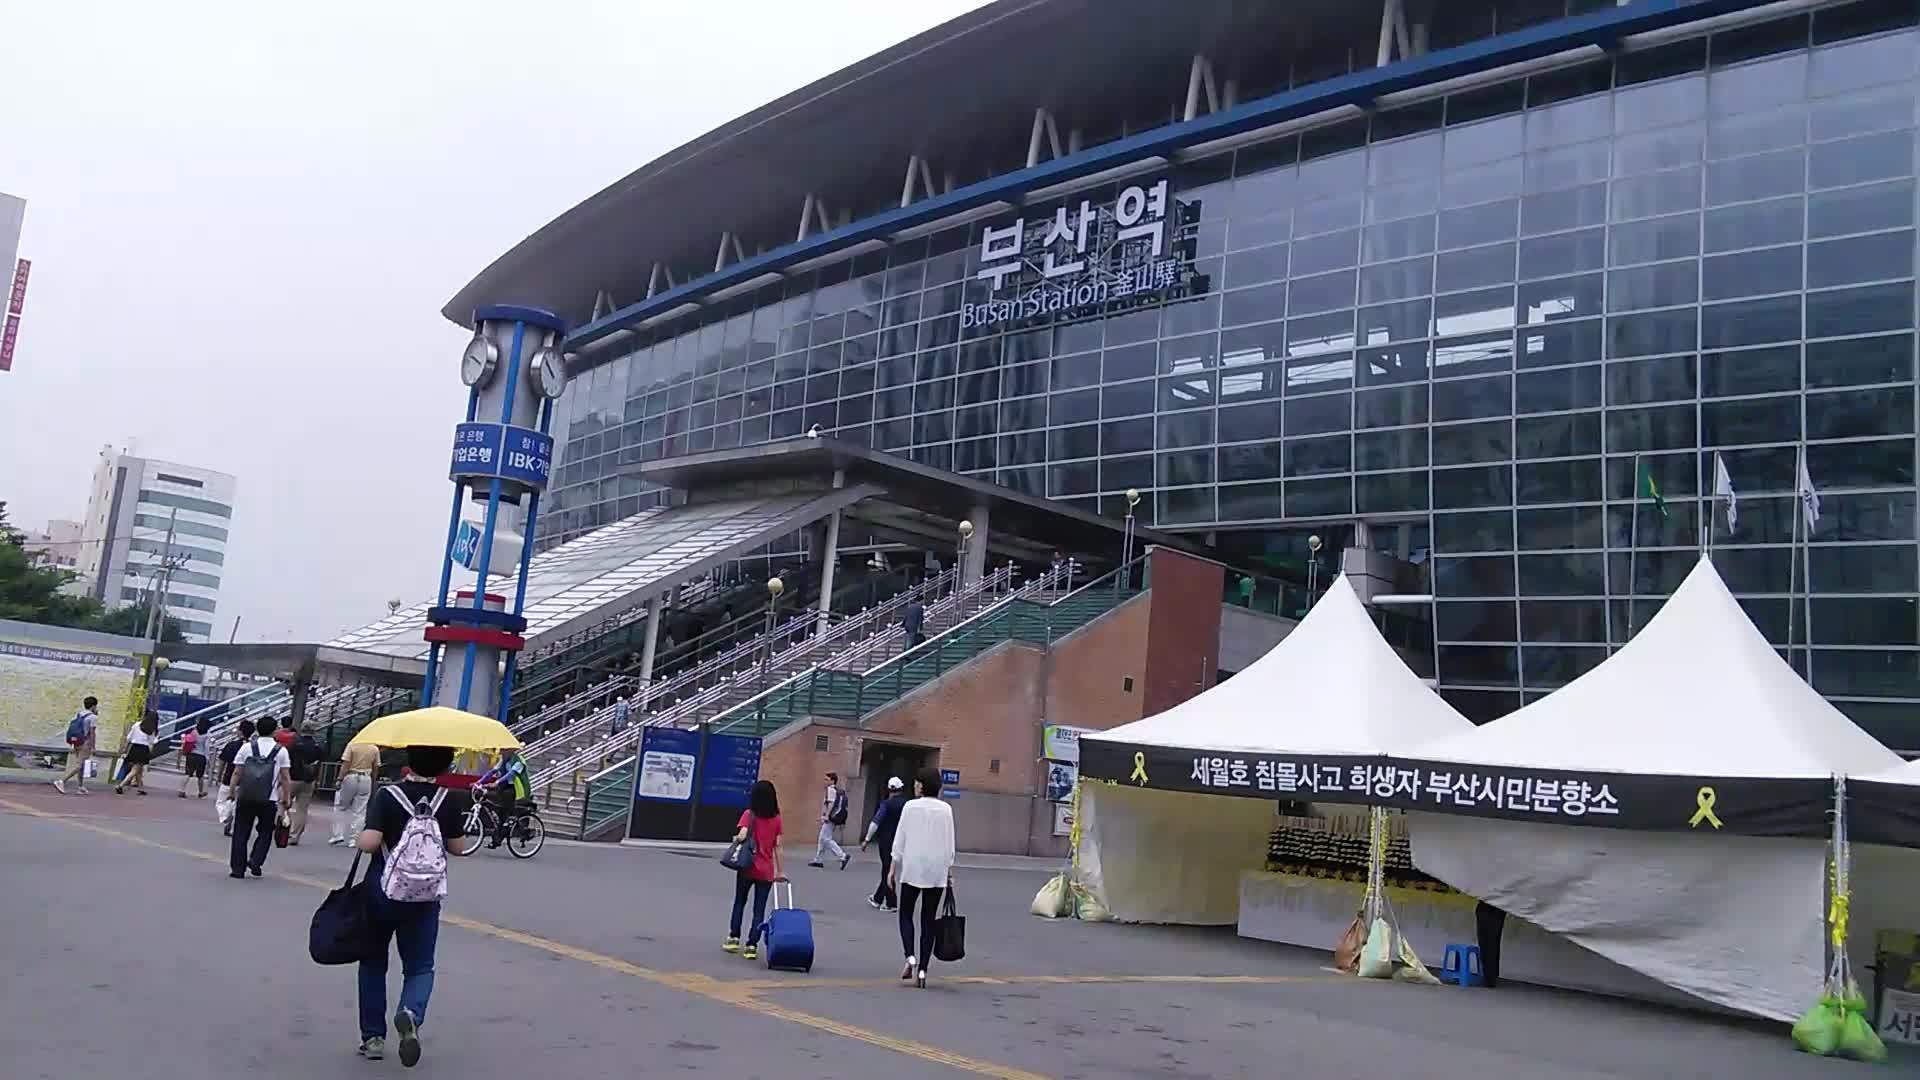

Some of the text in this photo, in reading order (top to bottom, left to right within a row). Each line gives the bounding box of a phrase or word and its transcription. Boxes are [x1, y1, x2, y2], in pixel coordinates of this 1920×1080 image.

[977, 179, 1168, 291] 부산역
[961, 297, 1024, 328] Busan
[1029, 280, 1108, 314] Station
[1190, 757, 1619, 816] 세월호 침몰사고 희생자 부산시민분향소
